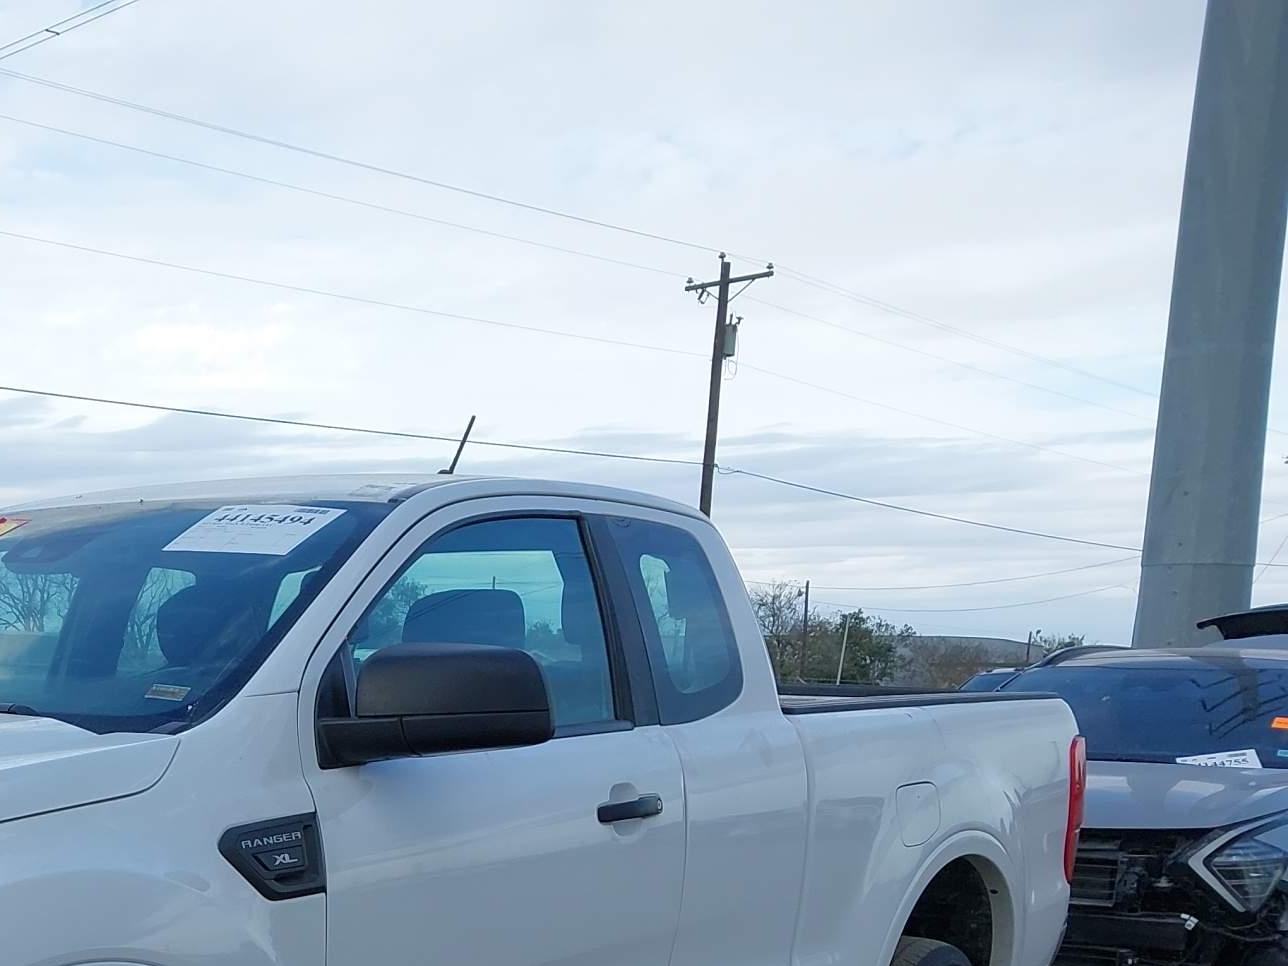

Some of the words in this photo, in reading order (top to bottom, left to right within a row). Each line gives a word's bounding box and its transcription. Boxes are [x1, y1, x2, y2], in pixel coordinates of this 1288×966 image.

[214, 513, 316, 526] 44145494
[241, 831, 302, 849] RANGER
[272, 853, 298, 866] XL
